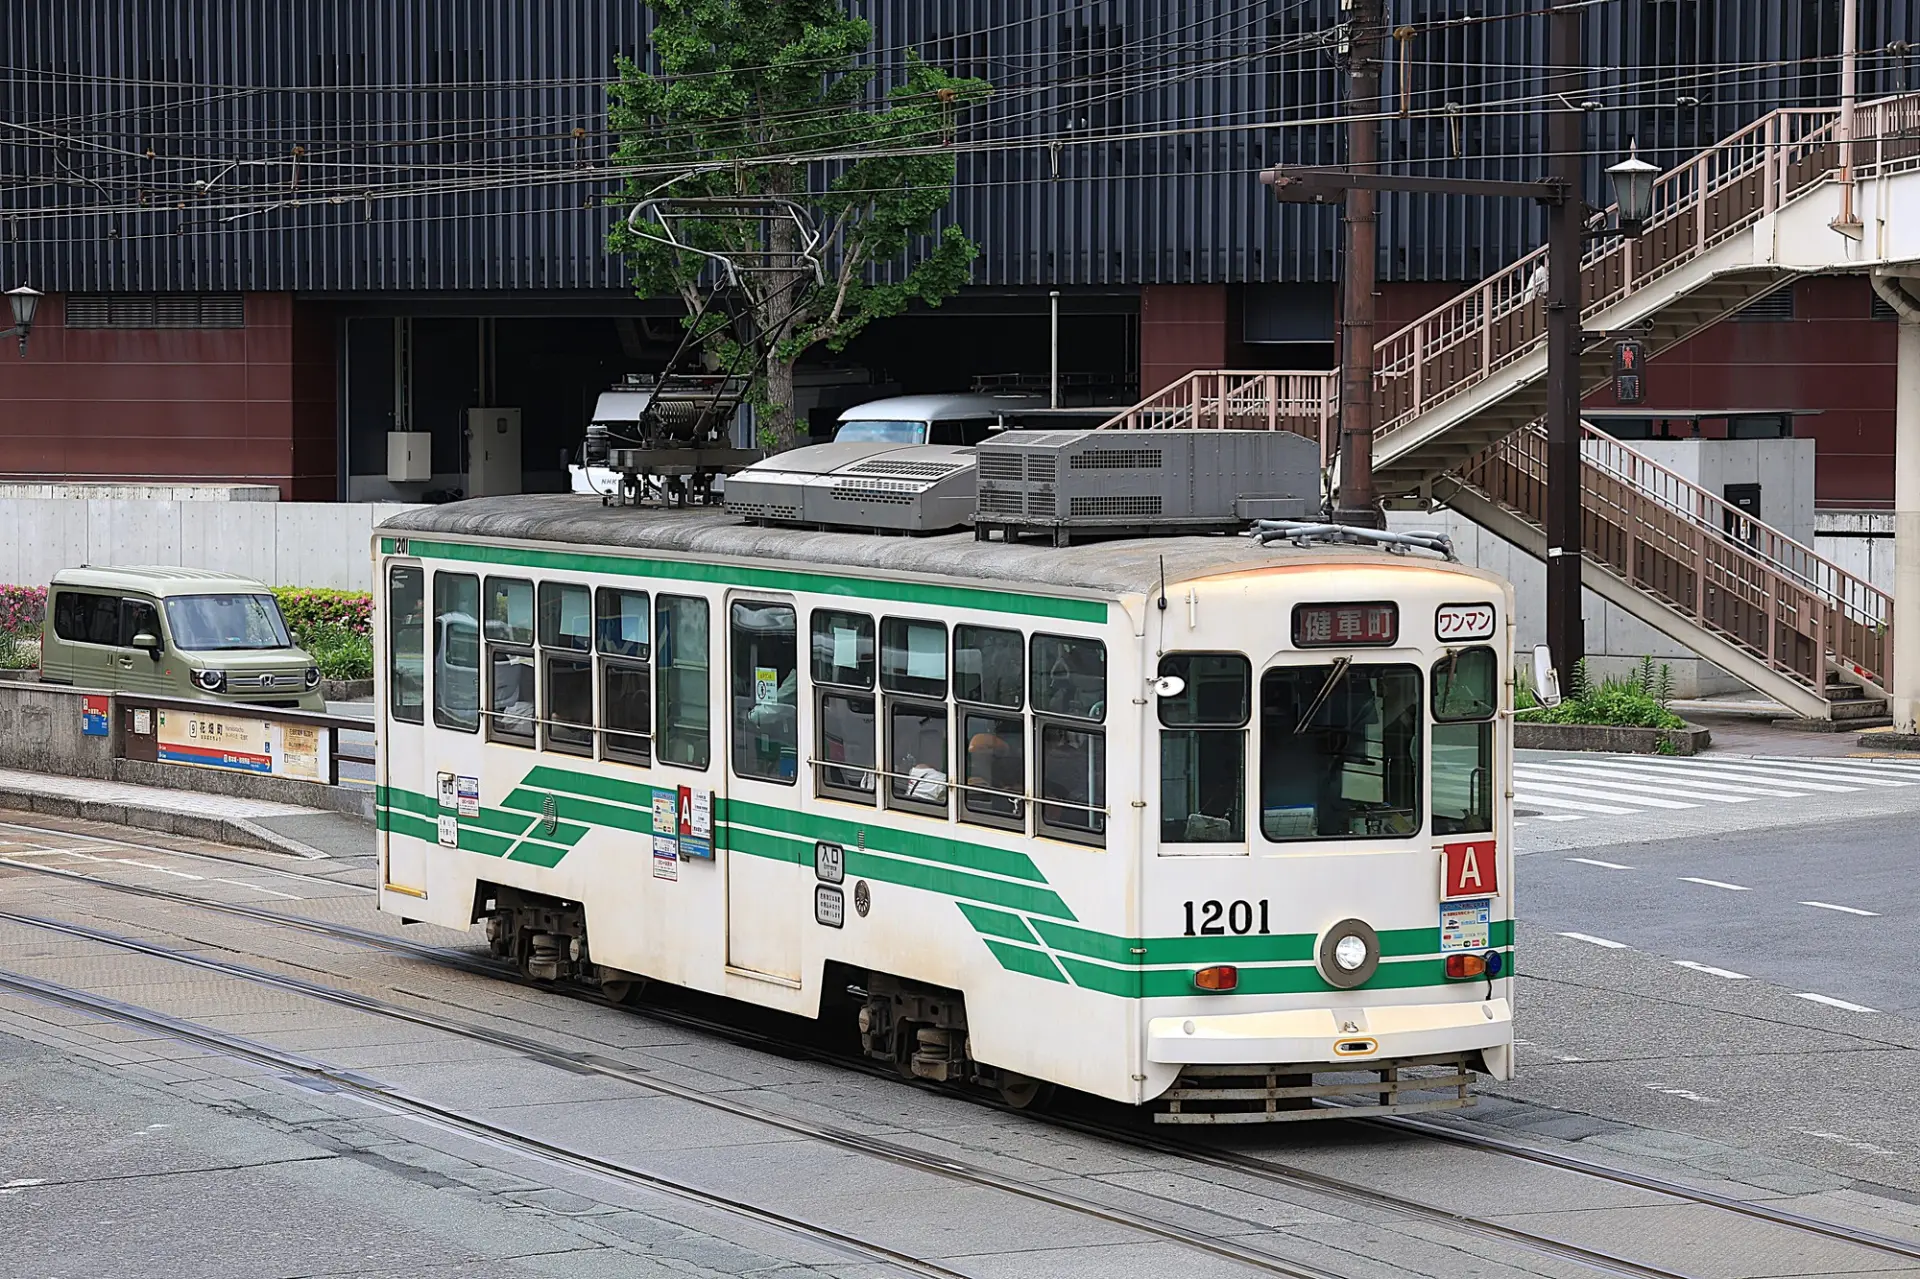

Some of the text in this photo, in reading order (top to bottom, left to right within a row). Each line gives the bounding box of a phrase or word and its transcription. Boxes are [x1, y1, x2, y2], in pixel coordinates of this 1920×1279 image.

[601, 478, 617, 486] NHK
[394, 537, 408, 555] 1201
[1304, 608, 1394, 641] 健軍町
[1439, 611, 1491, 633] ワンマン
[680, 795, 691, 826] A
[821, 846, 839, 865] 入口
[1459, 846, 1482, 889] A
[1183, 899, 1271, 936] 1201
